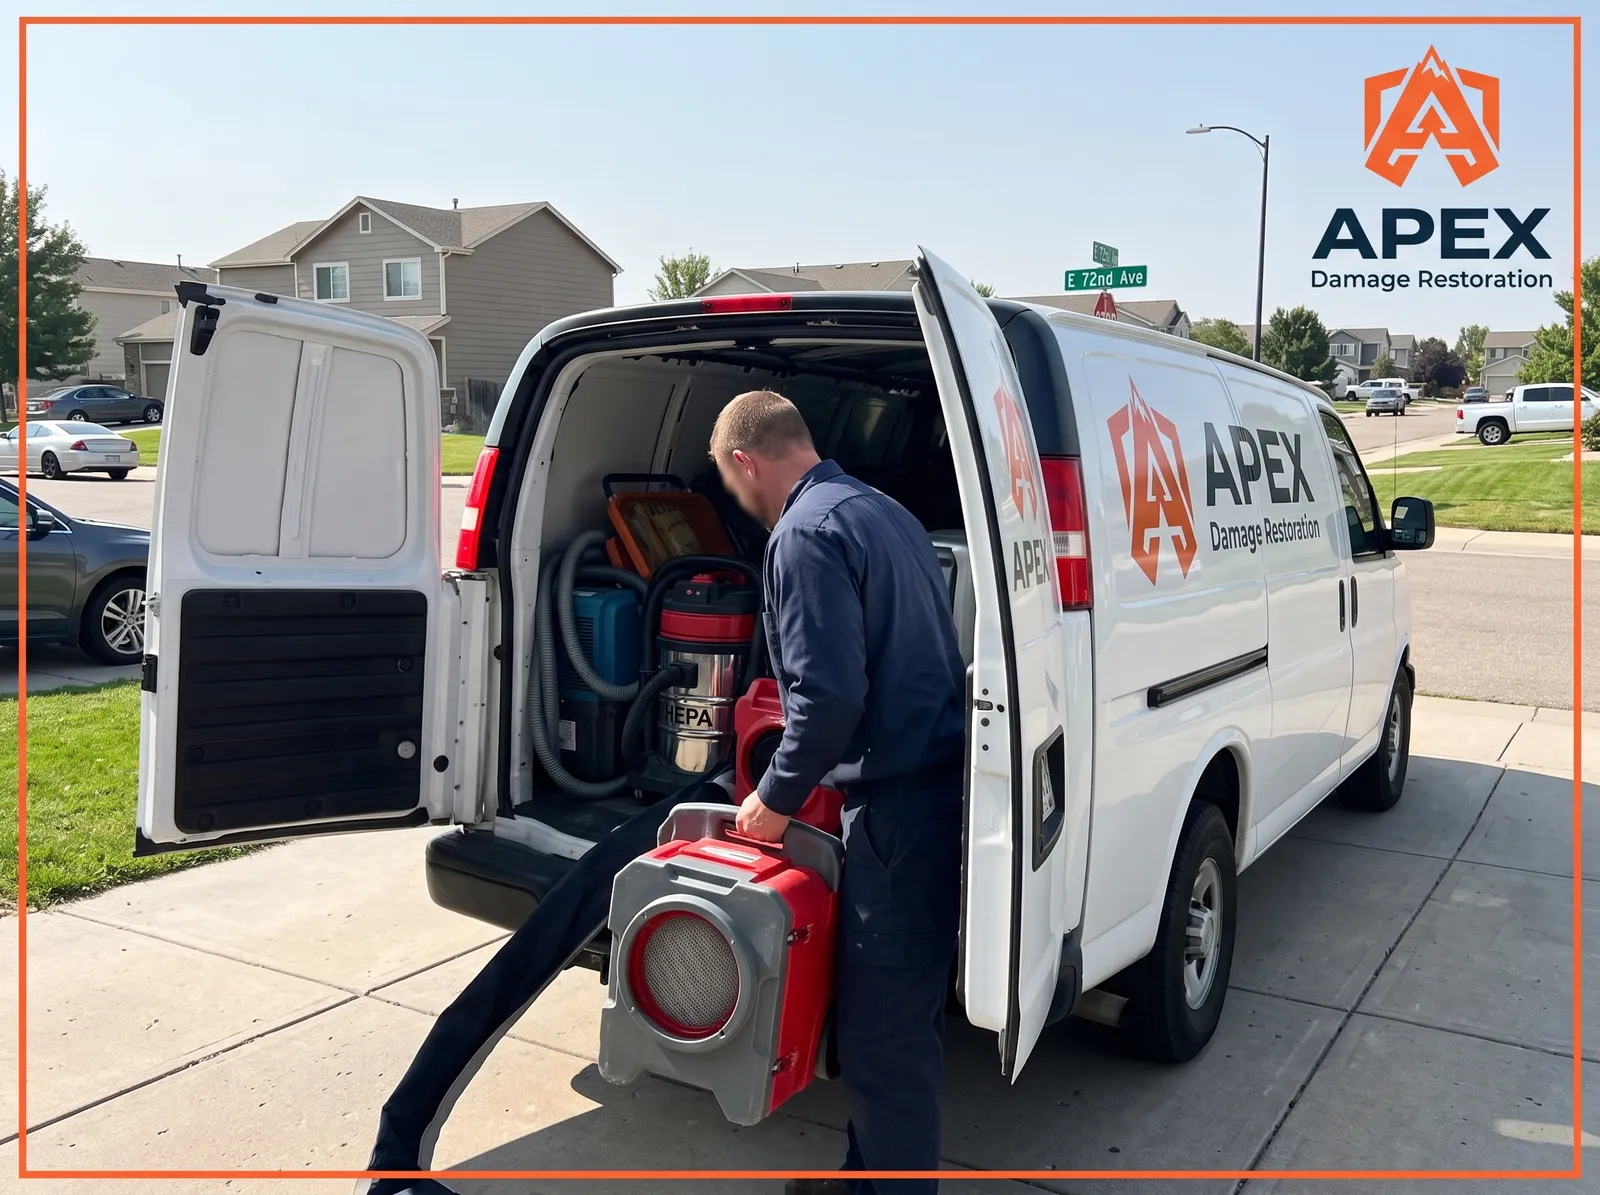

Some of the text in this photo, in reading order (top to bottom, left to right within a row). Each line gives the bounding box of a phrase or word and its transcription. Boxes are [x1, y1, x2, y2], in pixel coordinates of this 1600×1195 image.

[1067, 270, 1144, 288] E 72nd Ave
[1203, 421, 1316, 507] APEX
[1209, 513, 1321, 554] Damage Restoration
[1013, 538, 1051, 592] APEX
[665, 705, 713, 727] HEPA
